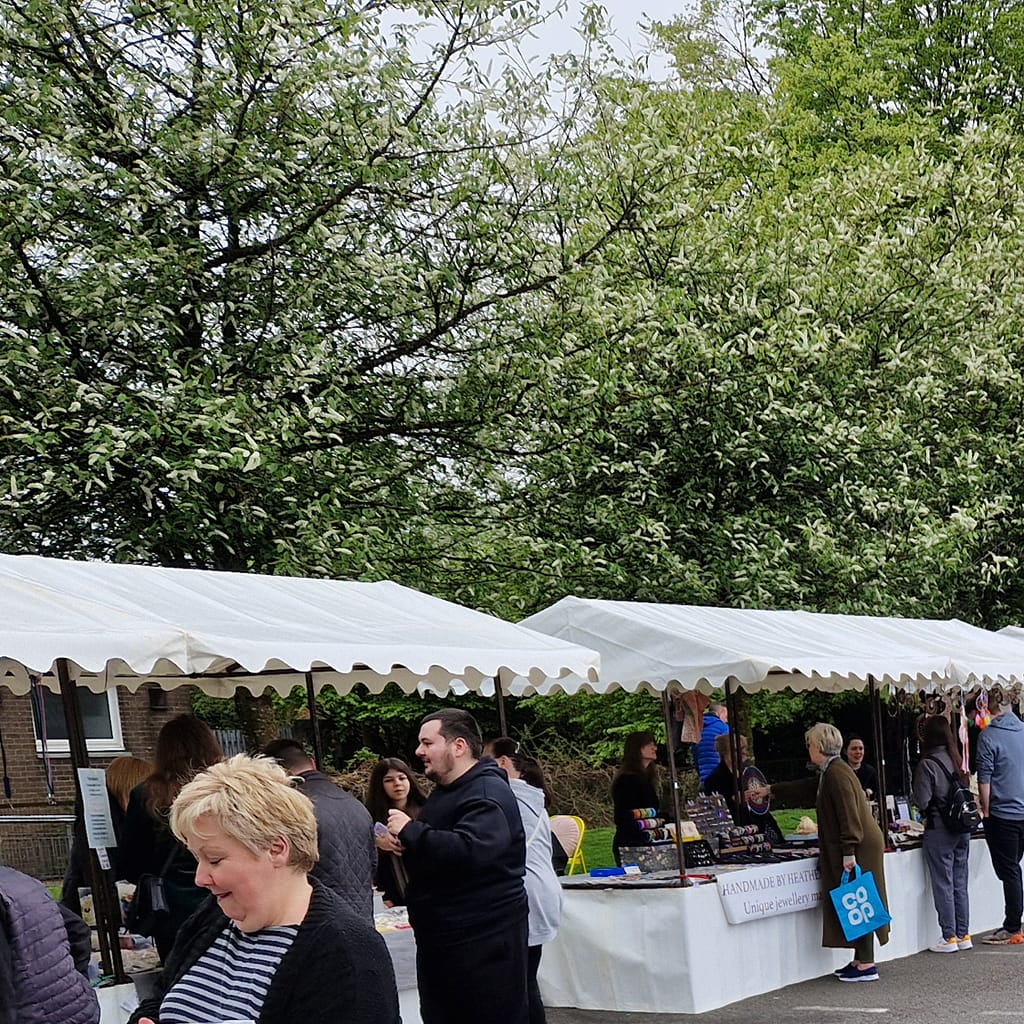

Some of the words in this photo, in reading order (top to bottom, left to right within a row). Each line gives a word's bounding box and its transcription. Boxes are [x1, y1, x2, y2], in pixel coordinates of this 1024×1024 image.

[722, 875, 777, 897] HANDMADE
[776, 873, 788, 887] BY
[787, 869, 822, 885] HEATHE
[743, 900, 774, 916] Unique
[774, 891, 811, 912] jewellery
